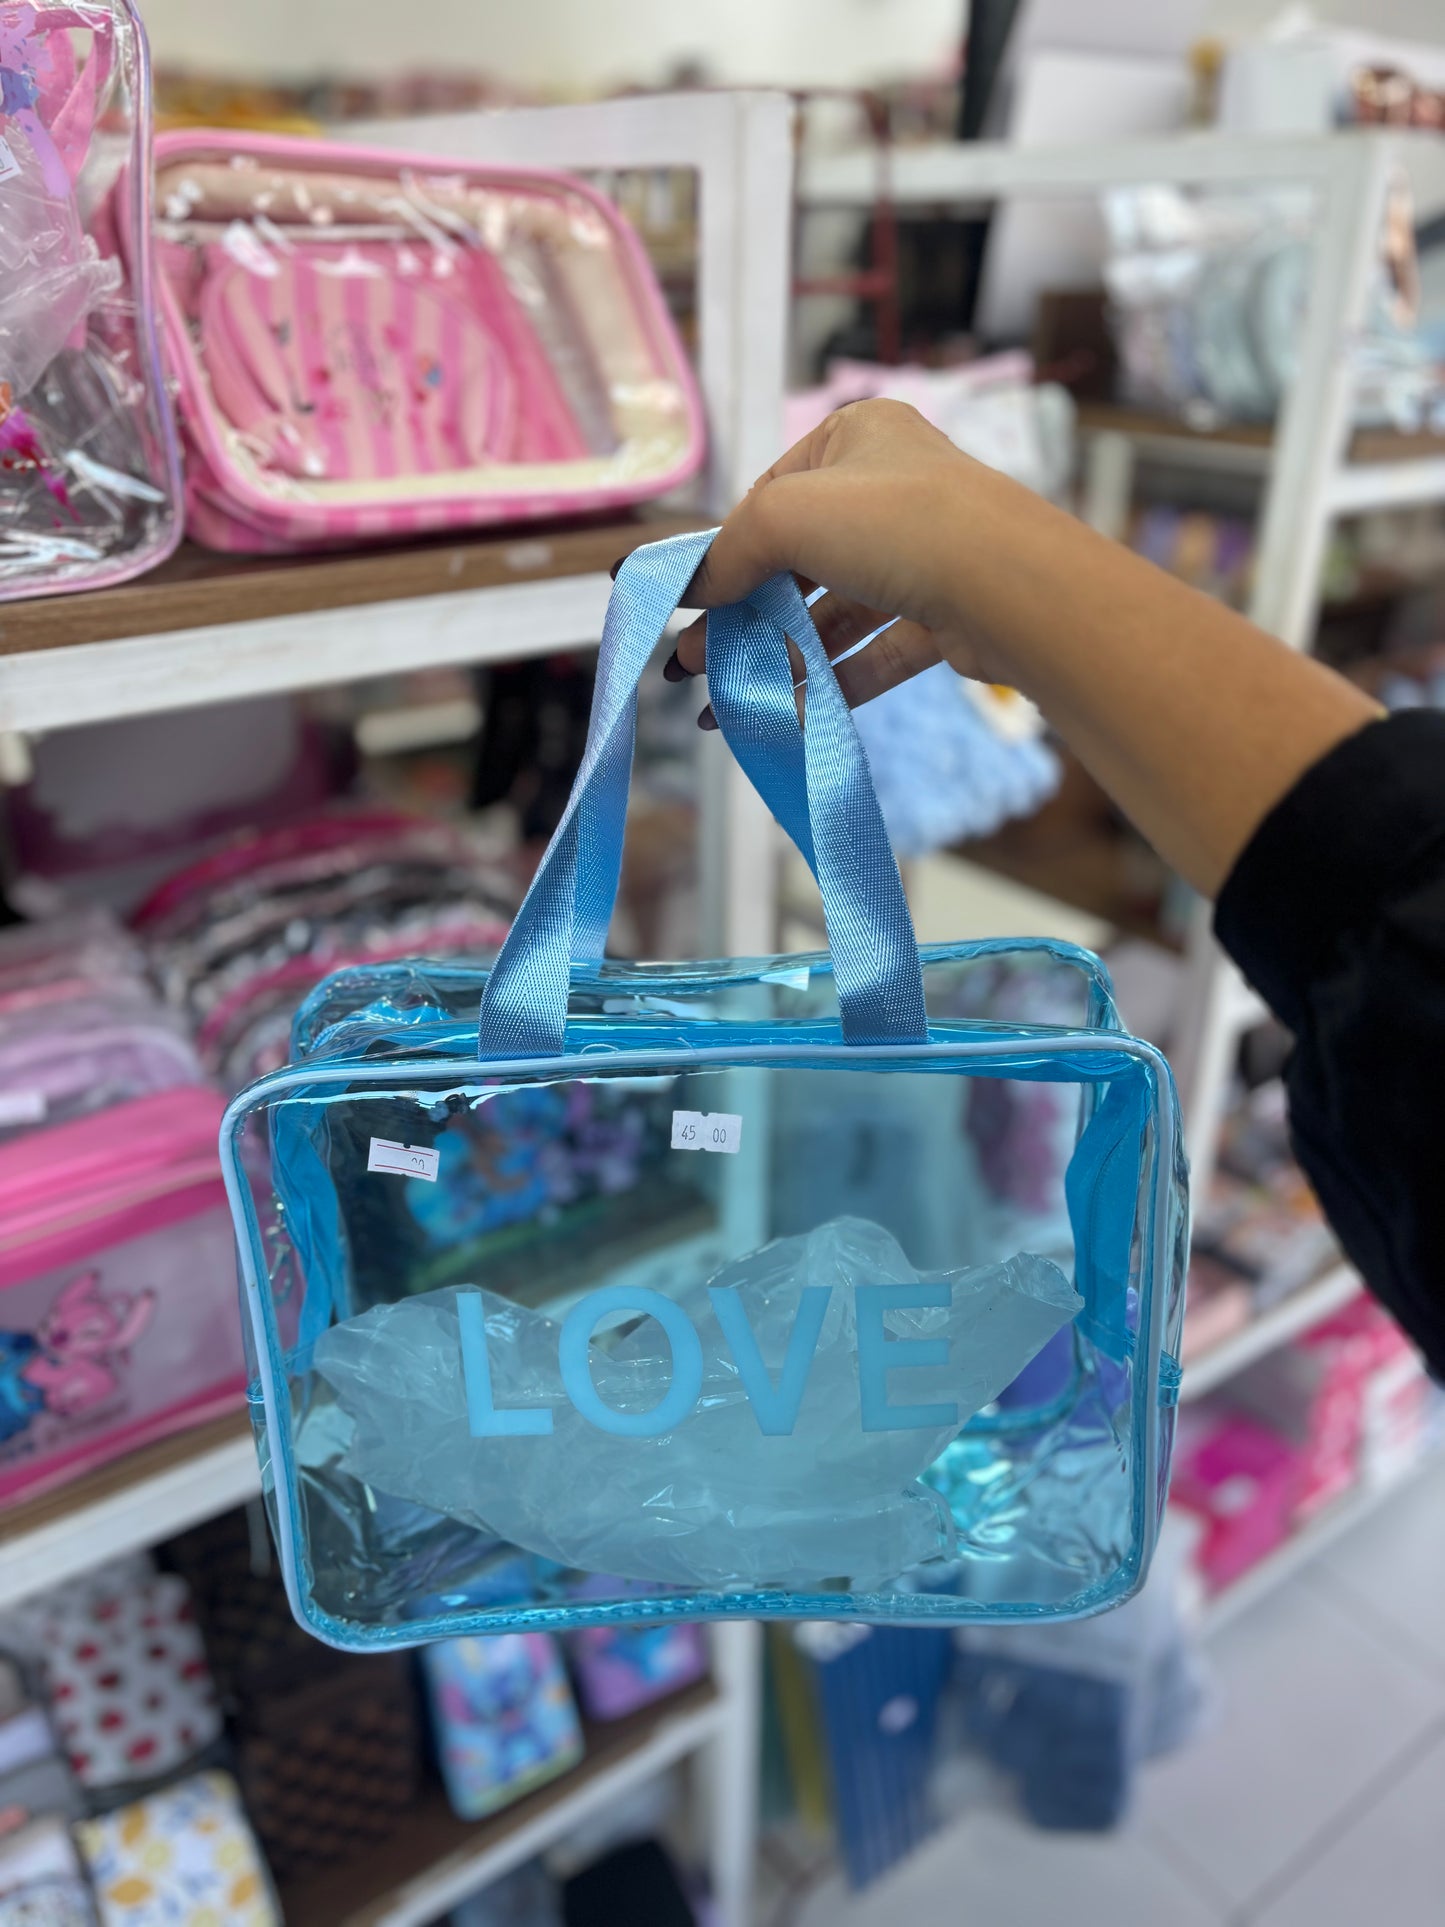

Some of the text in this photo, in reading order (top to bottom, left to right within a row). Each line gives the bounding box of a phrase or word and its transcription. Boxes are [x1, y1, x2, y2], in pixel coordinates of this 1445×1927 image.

[681, 1124, 727, 1144] 45 00
[456, 1283, 958, 1438] LOVE
